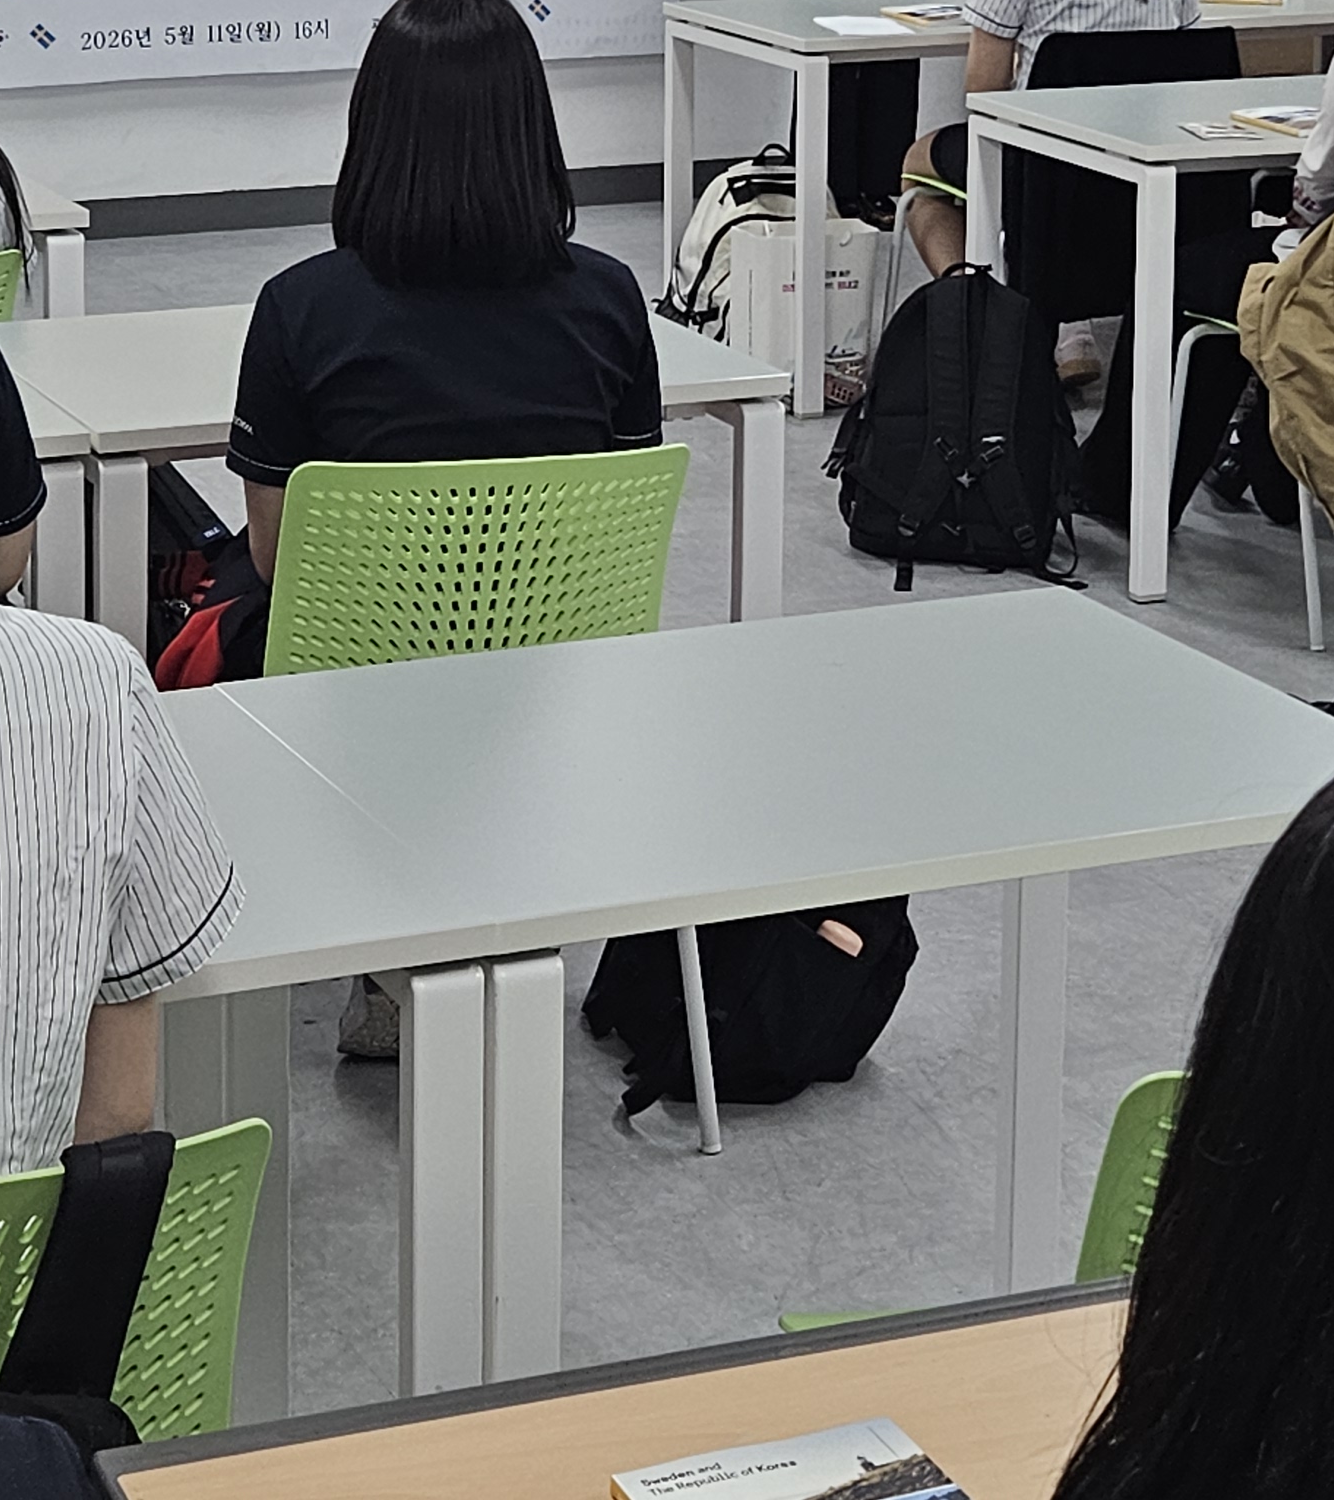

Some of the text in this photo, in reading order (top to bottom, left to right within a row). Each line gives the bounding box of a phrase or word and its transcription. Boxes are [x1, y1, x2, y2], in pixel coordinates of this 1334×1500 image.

[80, 18, 330, 51] 2026년 5월 11일(월) 16시
[641, 1462, 722, 1487] Sweden and
[648, 1485, 674, 1497] The
[676, 1471, 738, 1491] Republic
[741, 1467, 754, 1476] of
